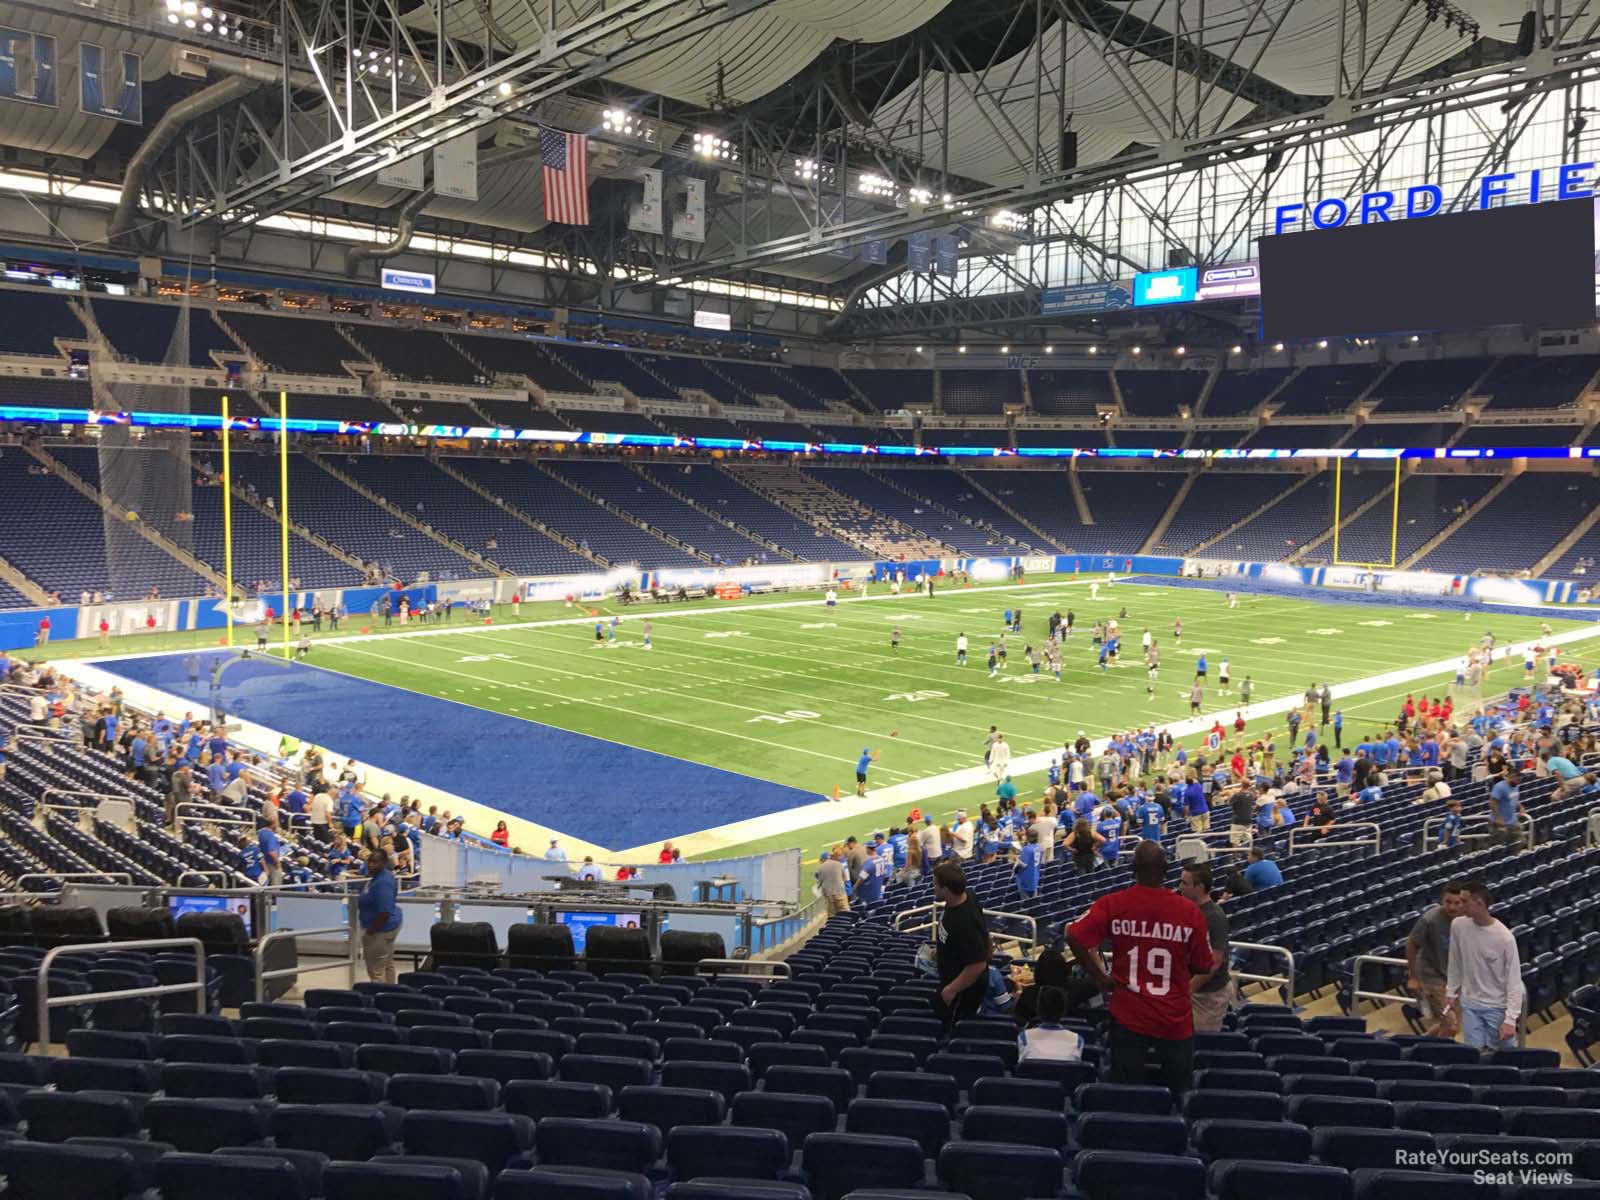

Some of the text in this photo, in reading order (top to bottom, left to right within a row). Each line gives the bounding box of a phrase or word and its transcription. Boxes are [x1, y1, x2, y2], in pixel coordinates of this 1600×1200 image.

[1274, 183, 1444, 236] FORD
[1111, 919, 1193, 943] GOLLADAY
[1126, 945, 1172, 996] 19
